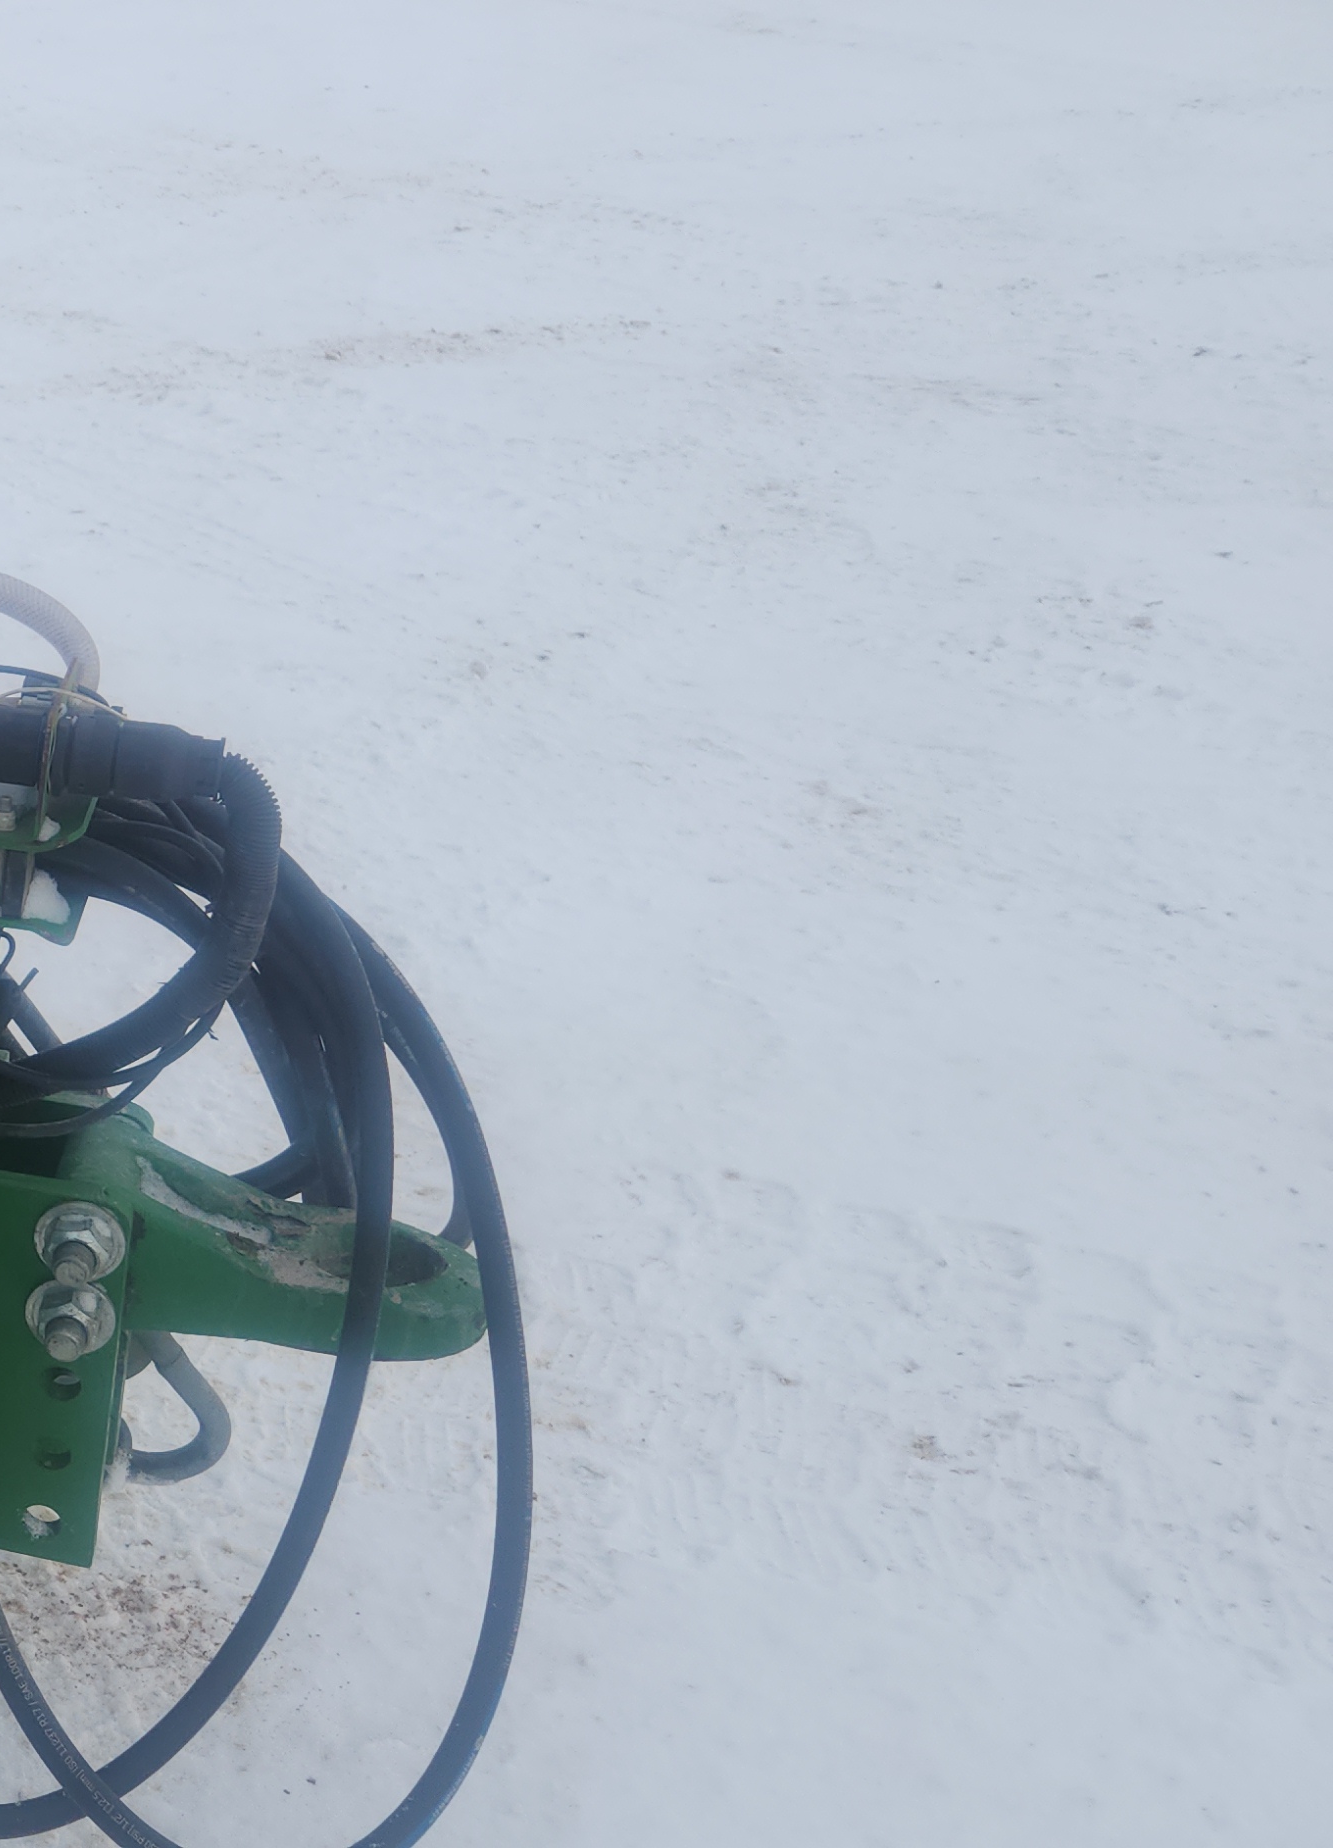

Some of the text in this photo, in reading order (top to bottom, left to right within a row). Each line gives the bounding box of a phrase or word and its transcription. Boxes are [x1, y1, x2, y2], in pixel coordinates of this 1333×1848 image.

[18, 1681, 34, 1701] SAE
[33, 1708, 49, 1728] R17
[44, 1727, 68, 1757] 11237
[64, 1755, 79, 1774] ISO
